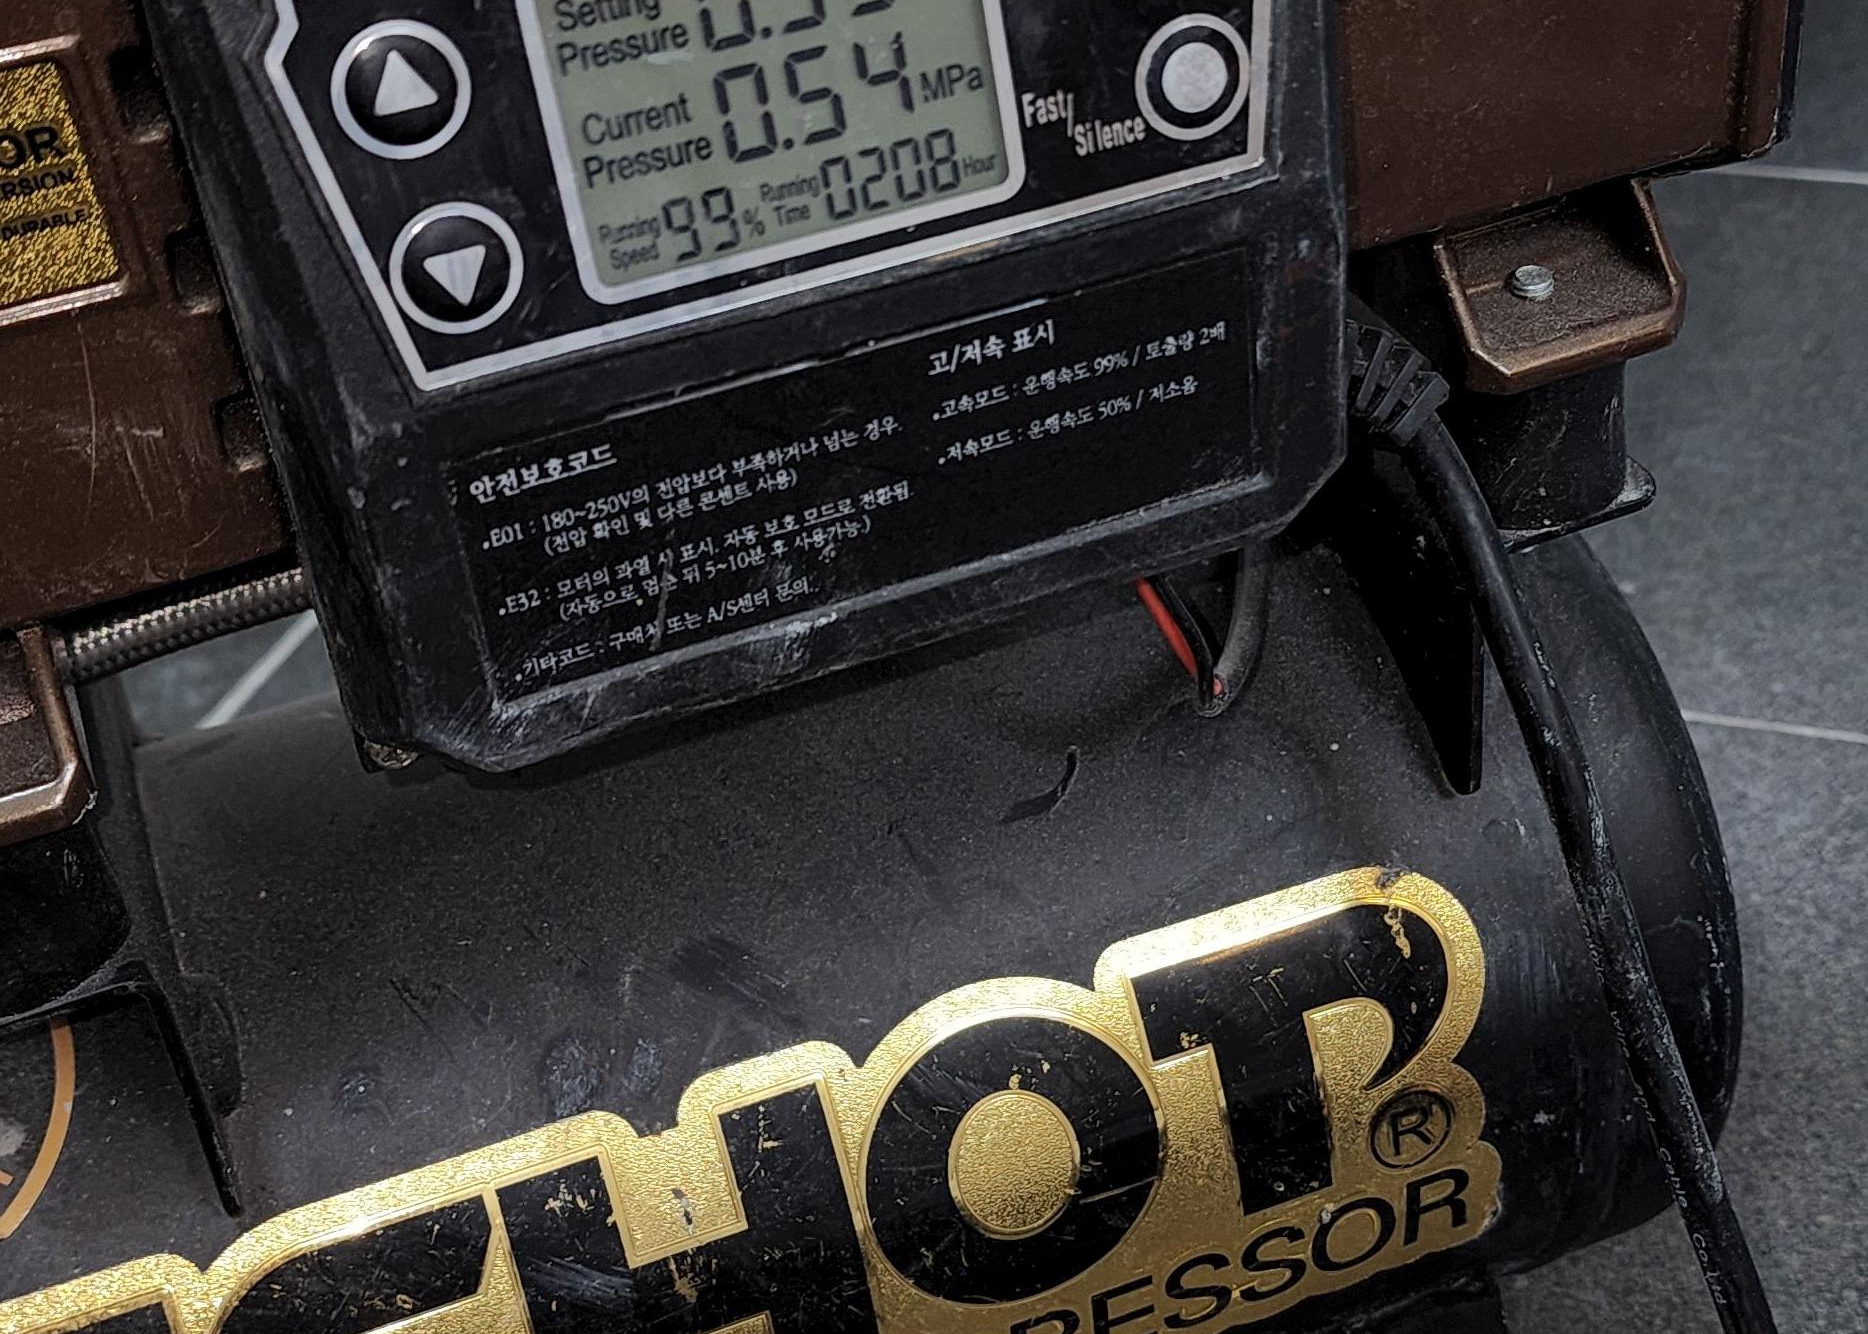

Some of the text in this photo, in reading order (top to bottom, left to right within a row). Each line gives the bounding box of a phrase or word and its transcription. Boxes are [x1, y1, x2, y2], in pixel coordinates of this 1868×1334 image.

[556, 23, 689, 77] Pressure
[581, 92, 691, 145] Current
[582, 31, 985, 189] Pressure 0.54 MPa
[1073, 115, 1147, 157] Silence
[759, 174, 821, 203] Running
[772, 128, 998, 228] Time 0208 Hour
[597, 216, 662, 244] Running
[609, 239, 660, 271] Speed
[927, 319, 1056, 376] 고/저속 표시
[1092, 349, 1130, 378] 99%
[1145, 328, 1196, 361] 토출량
[1199, 320, 1227, 346] 2배
[1097, 394, 1133, 419] 50%
[1149, 374, 1199, 404] 저소음
[469, 443, 618, 504] 안전보호코드
[542, 483, 651, 533] 180~250V의
[654, 463, 727, 501] 전압보다
[731, 436, 820, 477] 부족하거나
[823, 428, 860, 453] 넘는
[543, 467, 799, 557] (전압 확인 및 다른 콘센트 사용)
[556, 566, 611, 599] 모터의
[615, 554, 653, 581] 과열
[722, 523, 760, 549] 자동
[763, 514, 801, 540] 보호
[802, 497, 857, 527] 모드로
[559, 583, 640, 622] (자동으로
[682, 562, 701, 585] 뒤
[704, 544, 767, 580] 5~10분
[769, 538, 789, 559] 후
[666, 611, 703, 636] 또는
[706, 587, 771, 624] A/S센터
